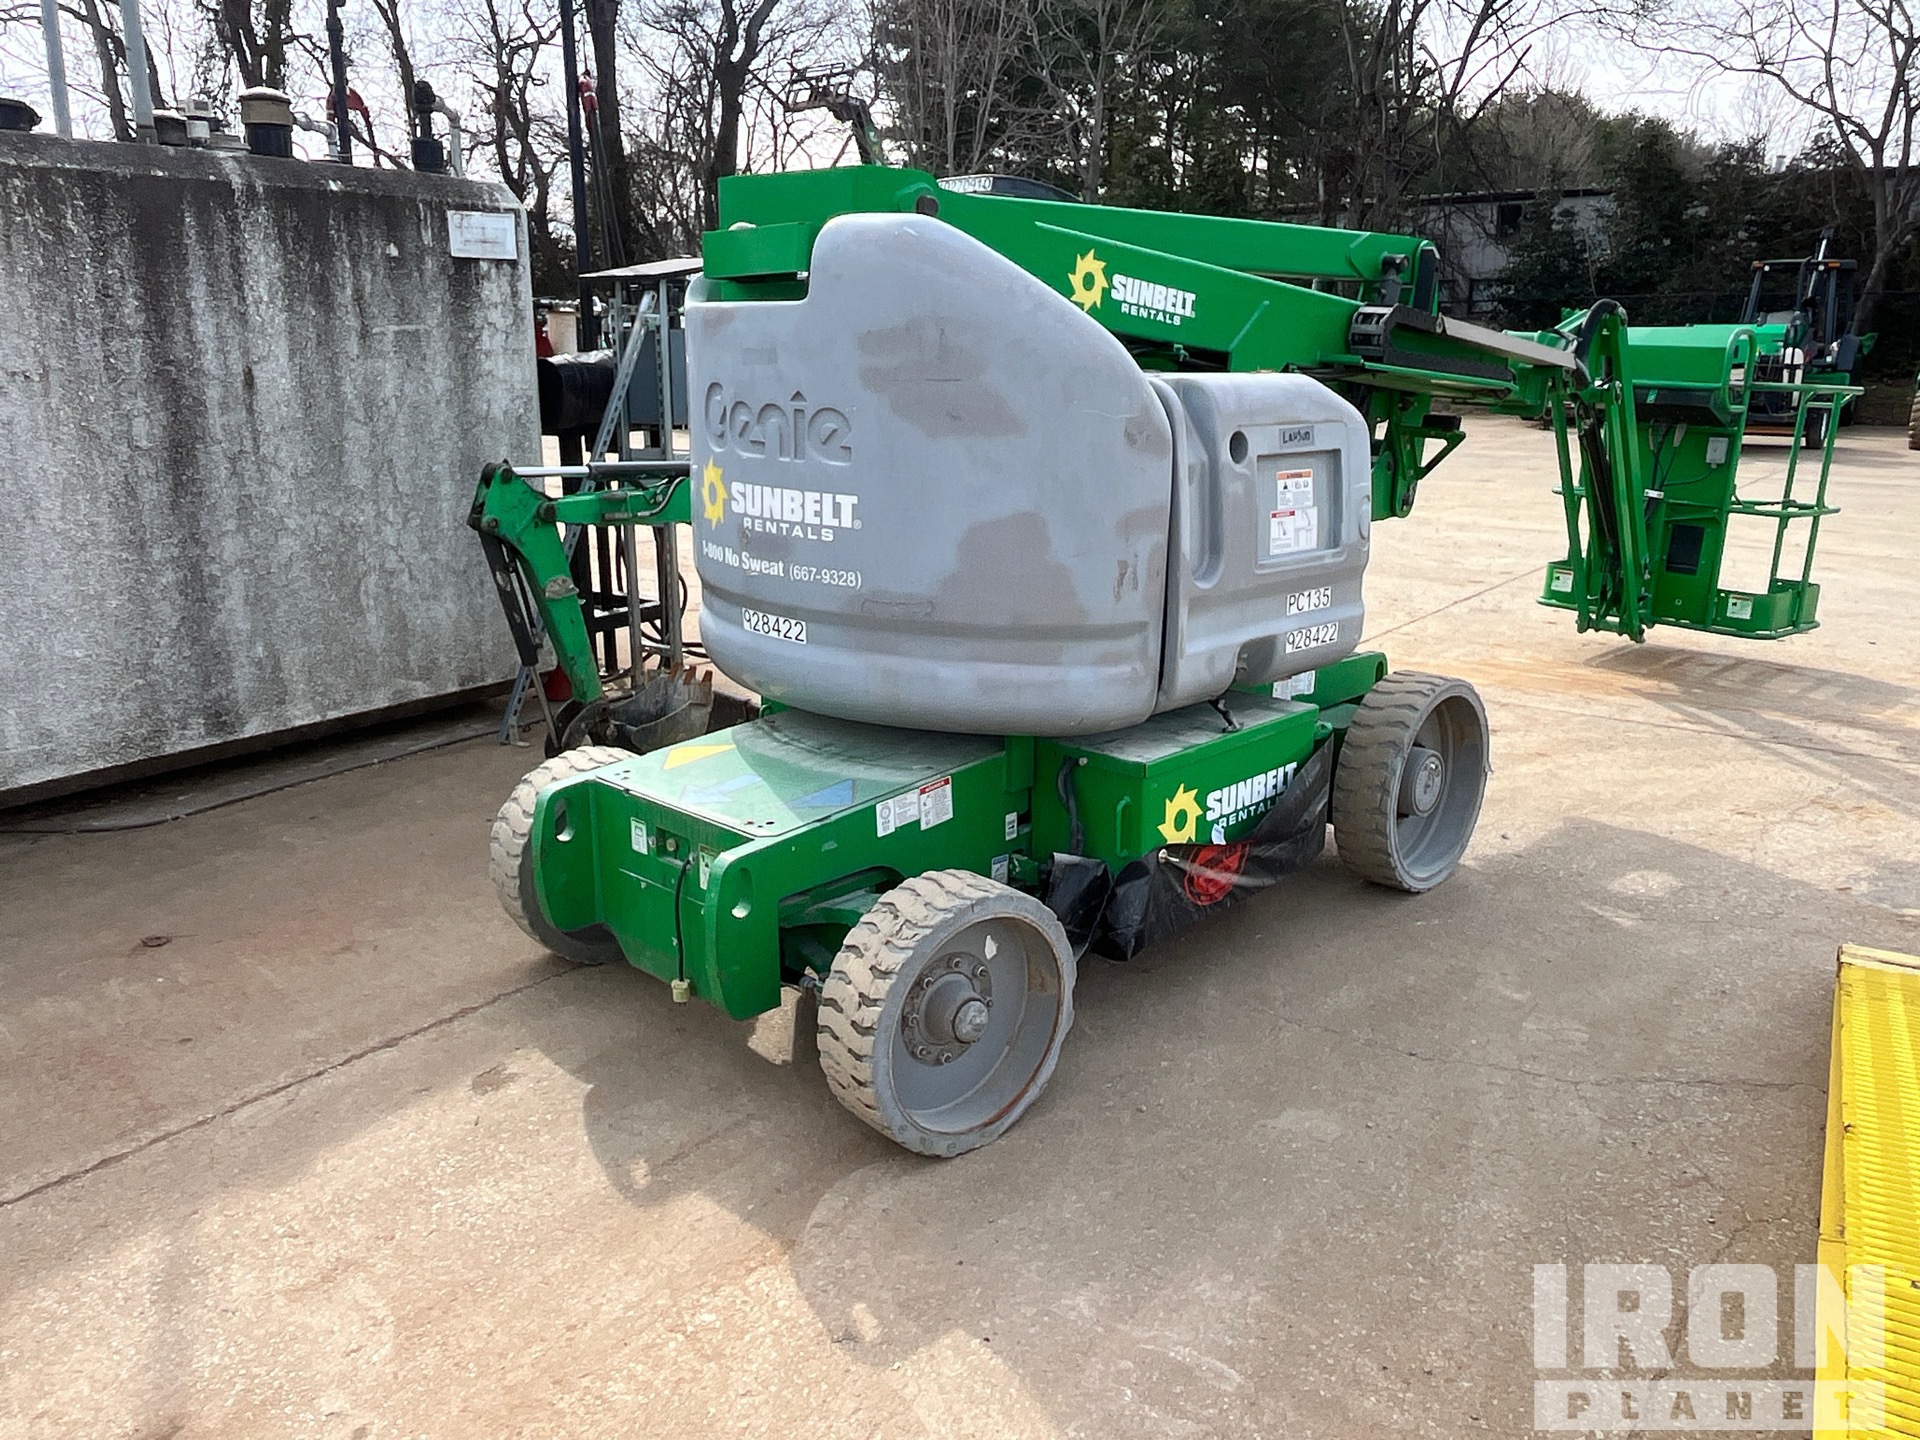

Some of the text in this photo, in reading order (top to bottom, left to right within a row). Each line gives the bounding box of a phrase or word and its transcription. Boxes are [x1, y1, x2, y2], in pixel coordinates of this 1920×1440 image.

[1110, 273, 1196, 319] SUNBELT
[1121, 302, 1181, 326] RENTALS
[704, 381, 853, 466] Genie
[730, 480, 859, 529] SUNBELT
[742, 517, 835, 542] RENTALS
[702, 539, 863, 591] 1-800 No Sweat (667-9328)
[1287, 587, 1331, 613] PC135
[743, 608, 807, 643] 928422
[1286, 623, 1338, 651] 928422
[1205, 761, 1298, 822] SUNBELT
[1217, 800, 1277, 829] RENTAL
